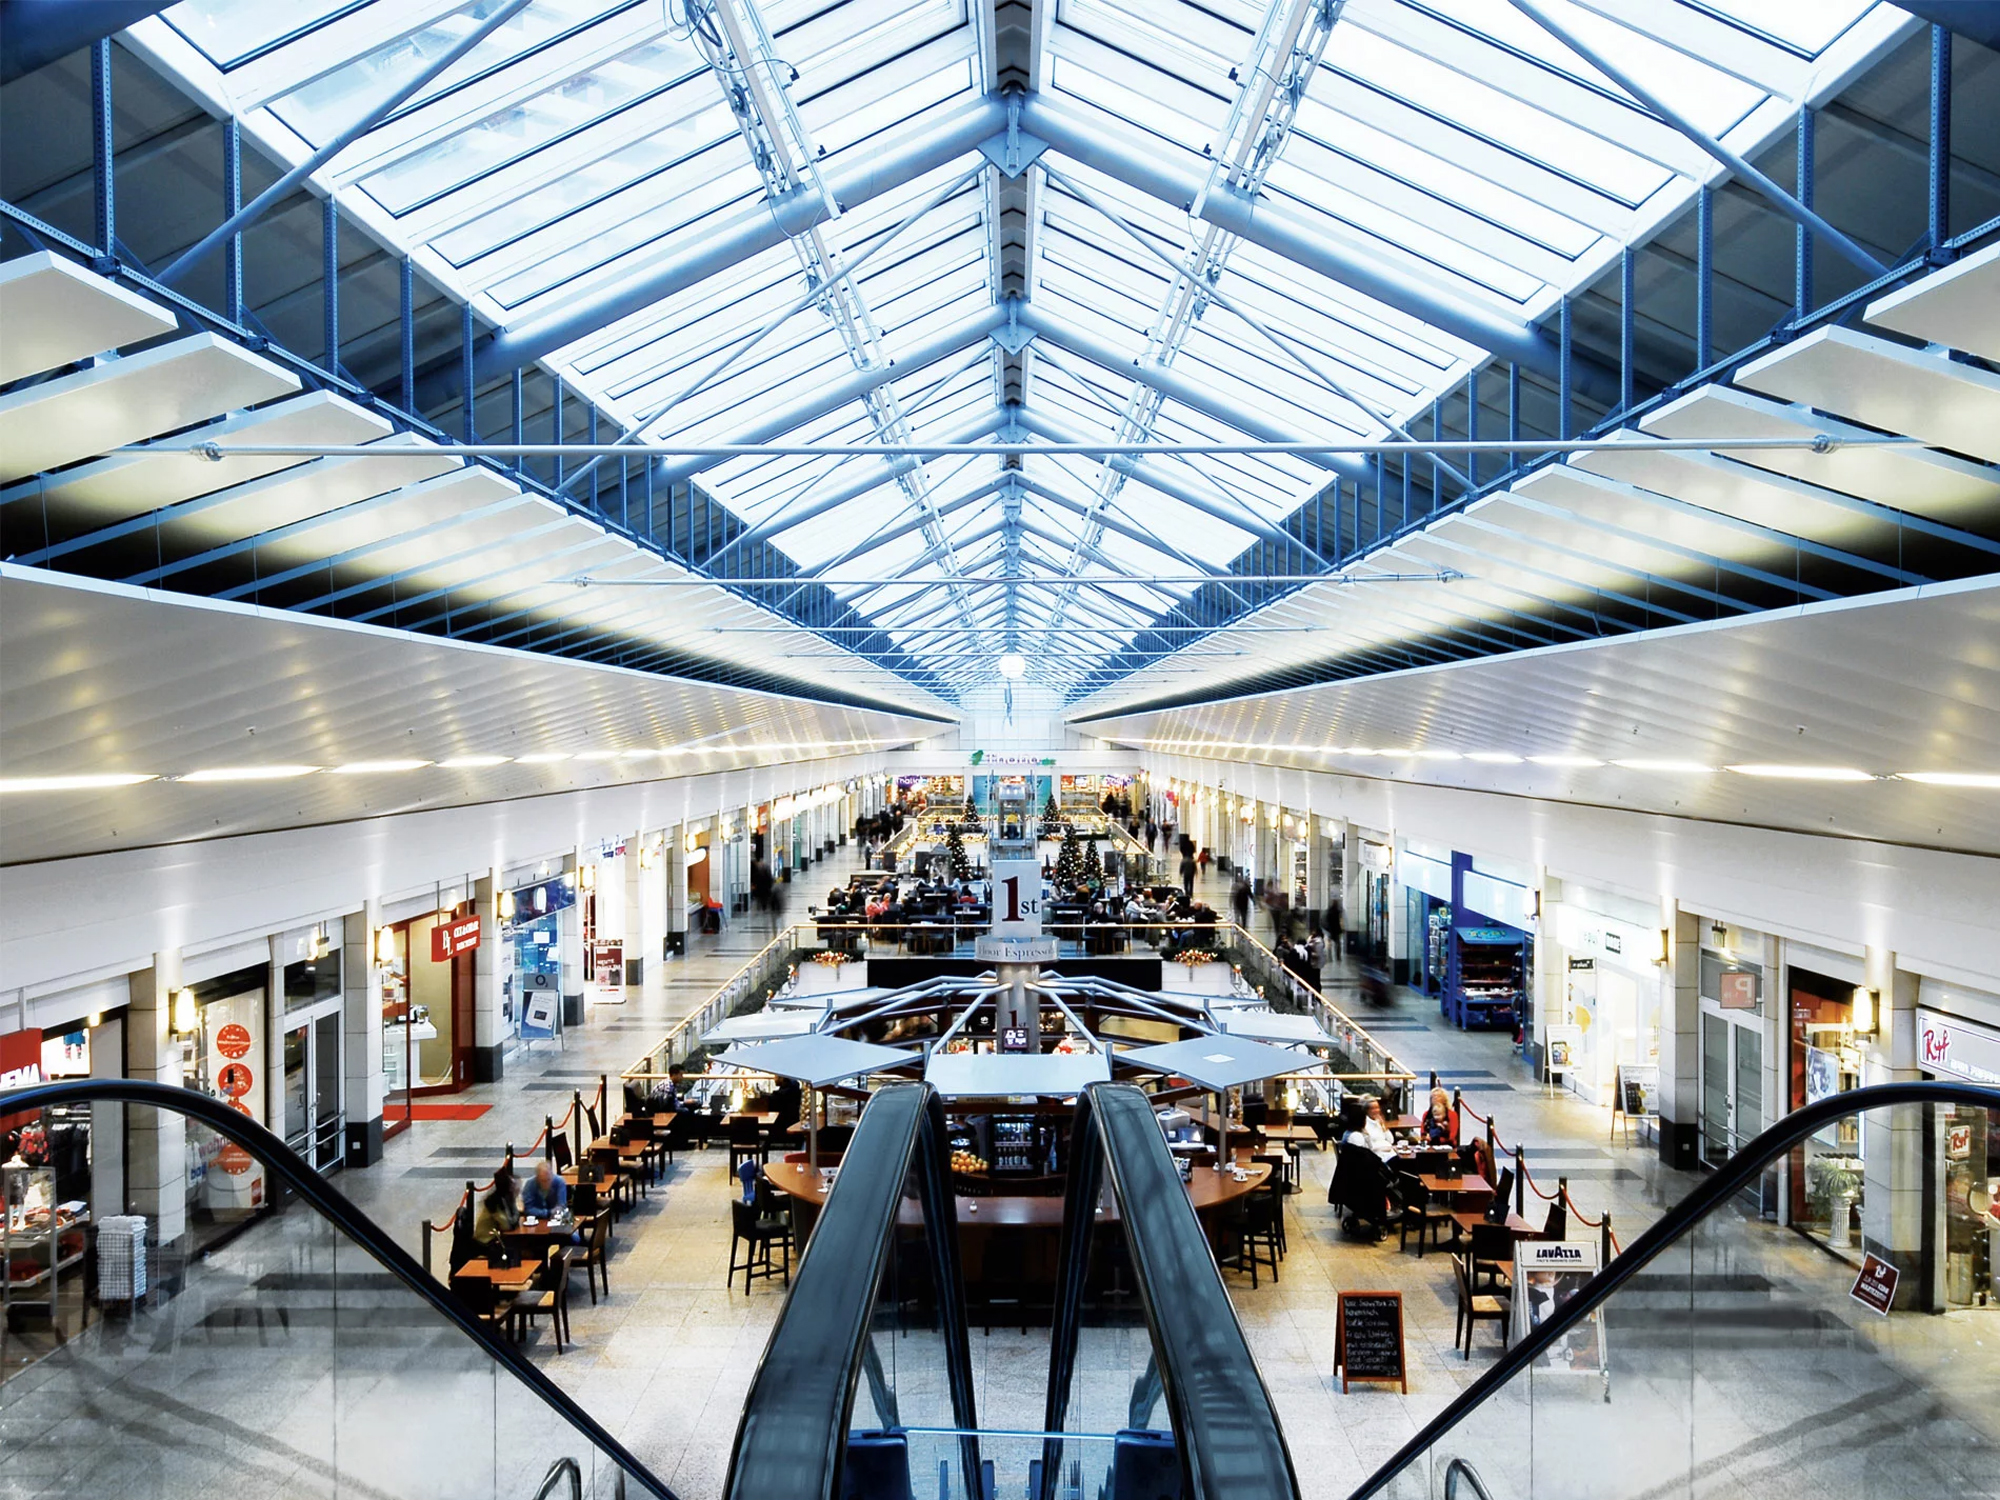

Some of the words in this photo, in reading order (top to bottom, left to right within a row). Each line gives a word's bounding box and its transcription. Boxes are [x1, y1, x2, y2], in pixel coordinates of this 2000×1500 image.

[1001, 875, 1040, 922] 1st
[0, 1062, 41, 1089] EMA
[1536, 1245, 1582, 1259] LAVAZZA
